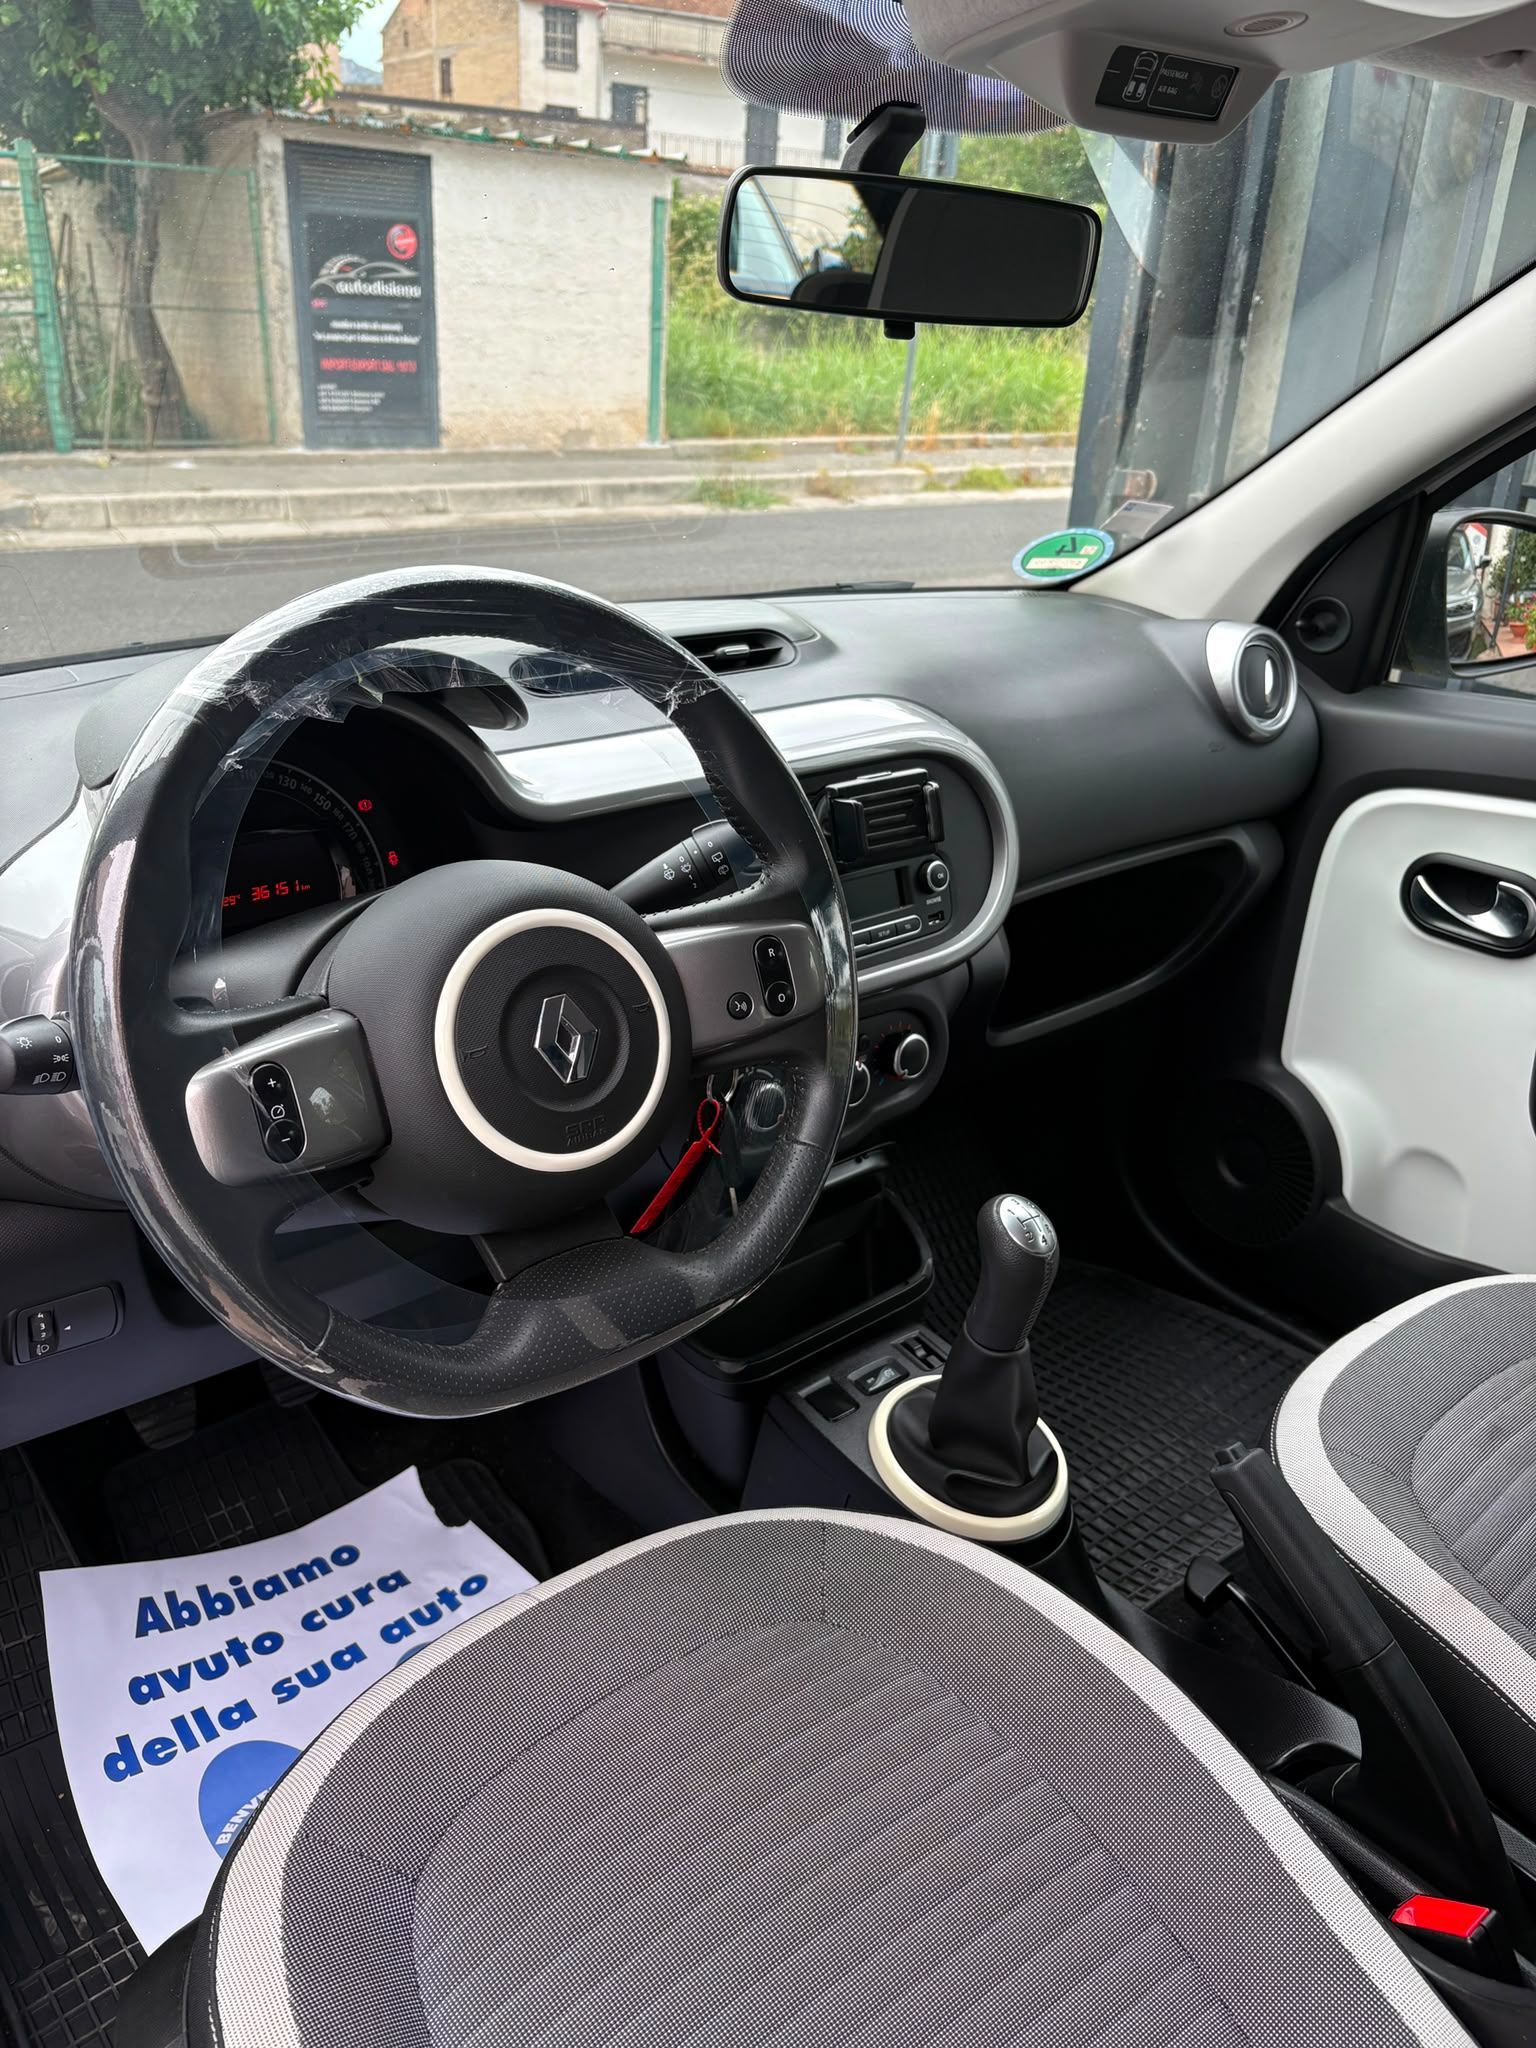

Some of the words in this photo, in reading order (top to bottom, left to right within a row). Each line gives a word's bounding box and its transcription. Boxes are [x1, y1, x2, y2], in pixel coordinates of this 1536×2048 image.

[1160, 68, 1189, 80] PASSENGER
[1157, 85, 1167, 93] AIR
[279, 774, 297, 790] 130
[313, 793, 332, 811] 150
[251, 879, 300, 902] 36151
[767, 947, 776, 958] R
[134, 1544, 361, 1639] Abbiamo
[128, 1630, 284, 1706] avuto
[300, 1569, 411, 1633] cura
[102, 1698, 258, 1783] della
[271, 1642, 367, 1705] sua
[379, 1574, 489, 1645] auto
